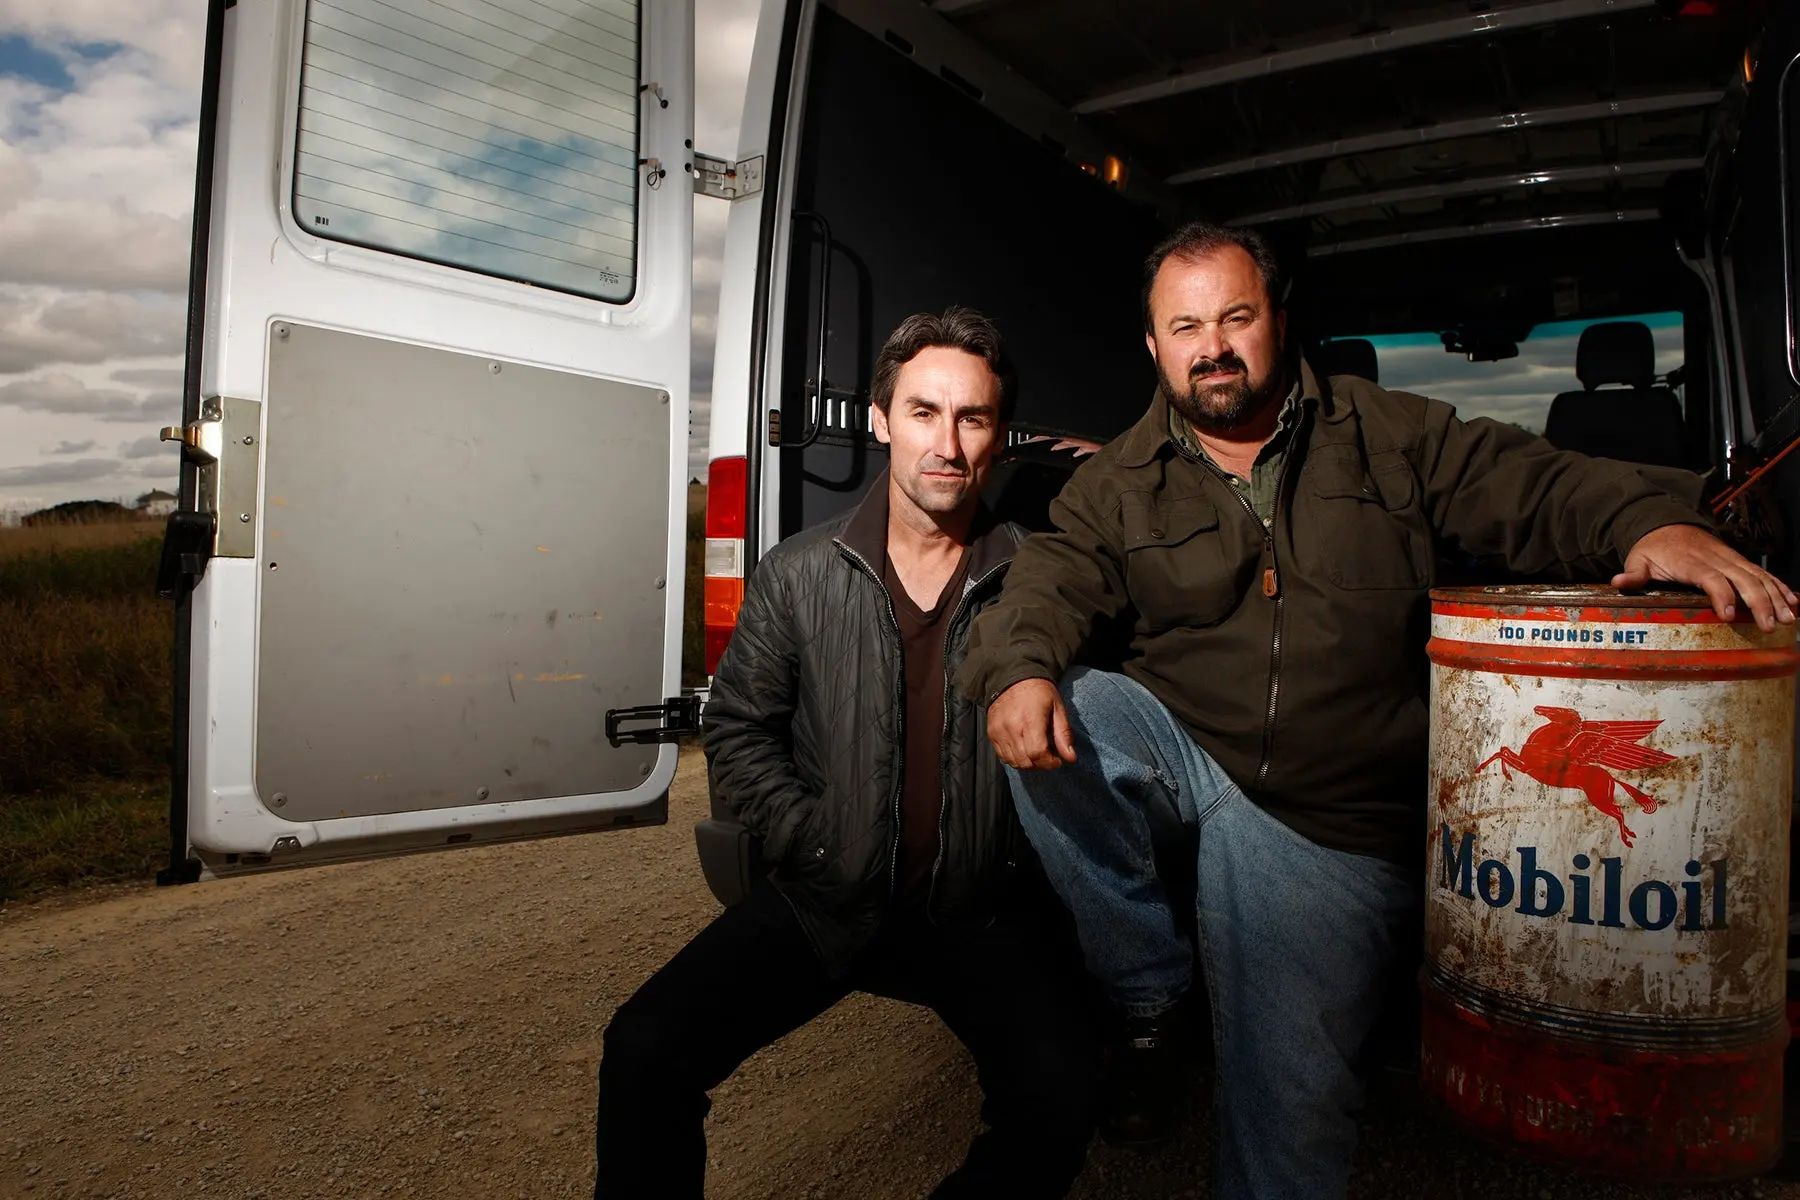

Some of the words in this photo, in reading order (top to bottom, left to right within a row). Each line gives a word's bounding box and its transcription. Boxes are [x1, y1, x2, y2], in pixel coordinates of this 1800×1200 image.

[1498, 626, 1524, 640] 100
[1531, 628, 1604, 643] POUNDS
[1613, 630, 1648, 644] NET
[1441, 823, 1730, 932] Mobiloil
